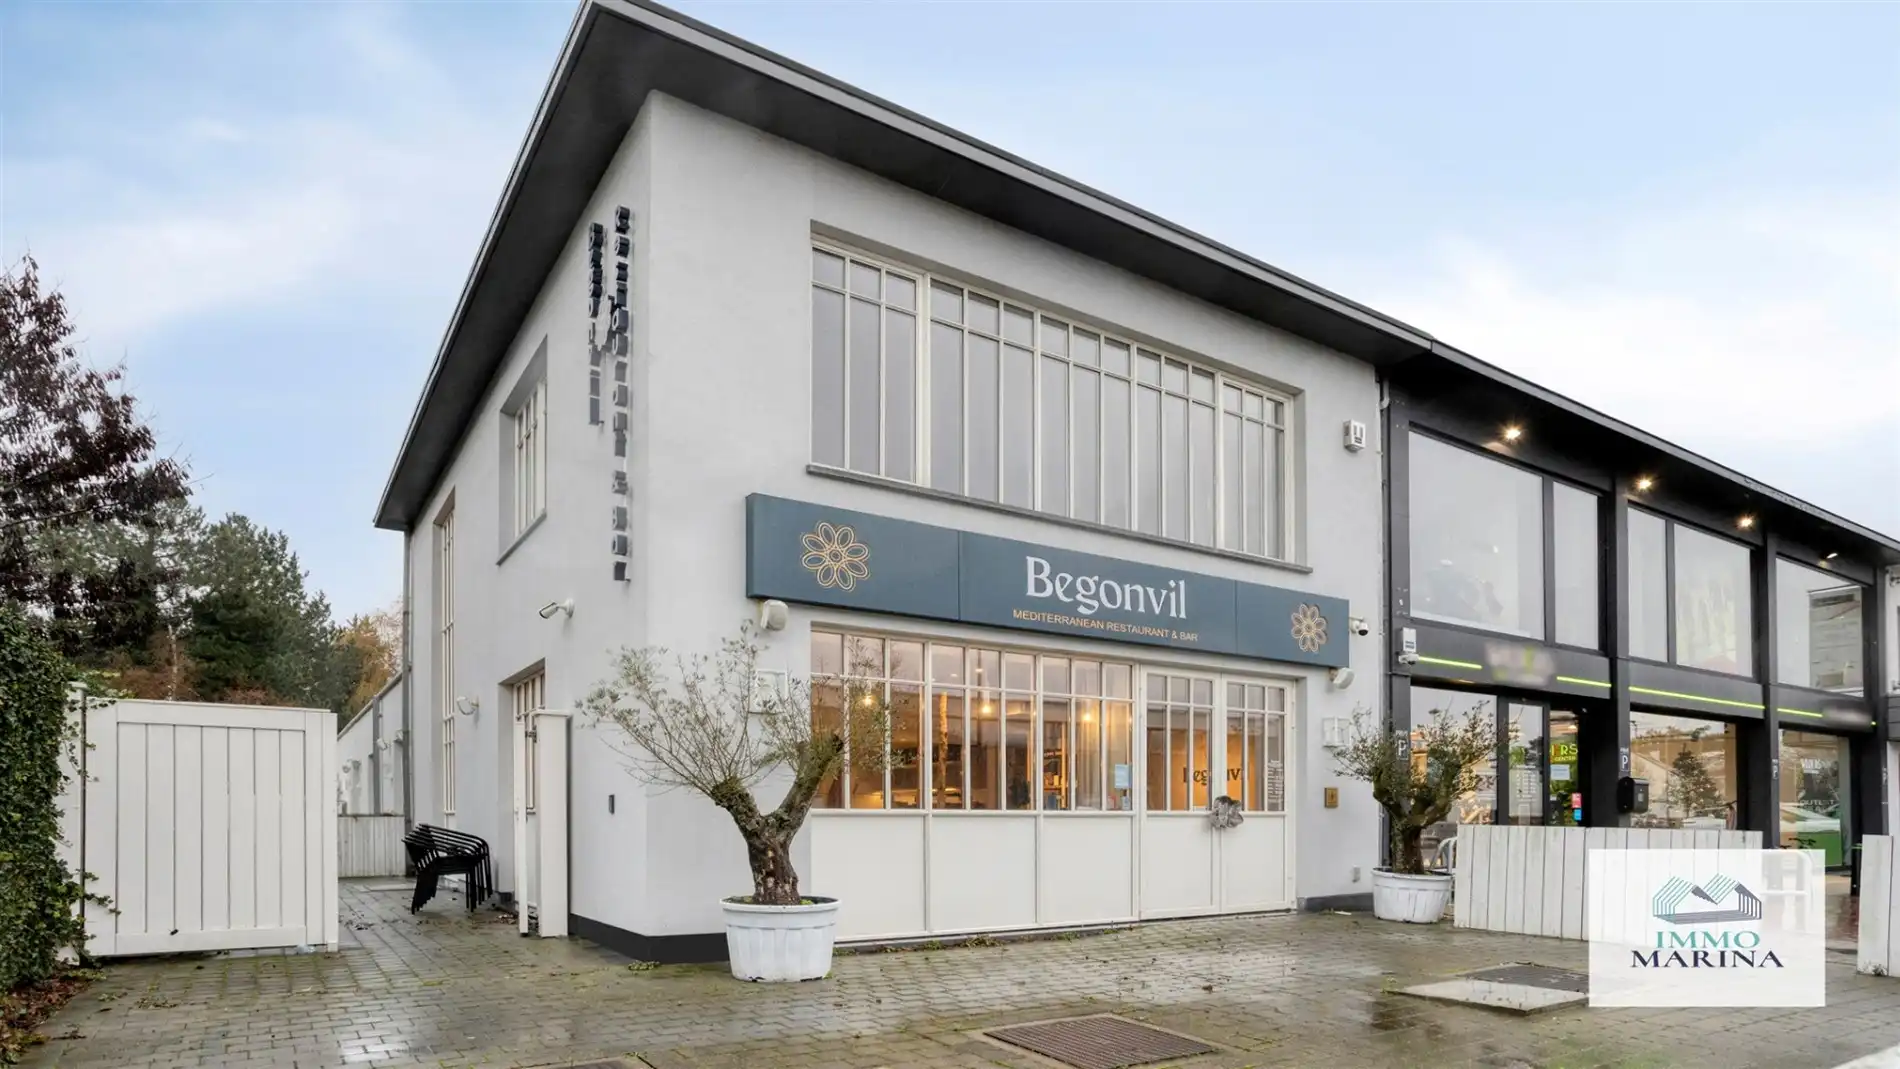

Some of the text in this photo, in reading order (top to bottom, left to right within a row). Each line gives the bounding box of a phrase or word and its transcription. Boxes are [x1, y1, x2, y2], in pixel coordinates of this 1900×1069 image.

[1025, 555, 1187, 619] Begonvil
[1012, 608, 1198, 642] MEDITERRANEAN RESTAURANT & BAR
